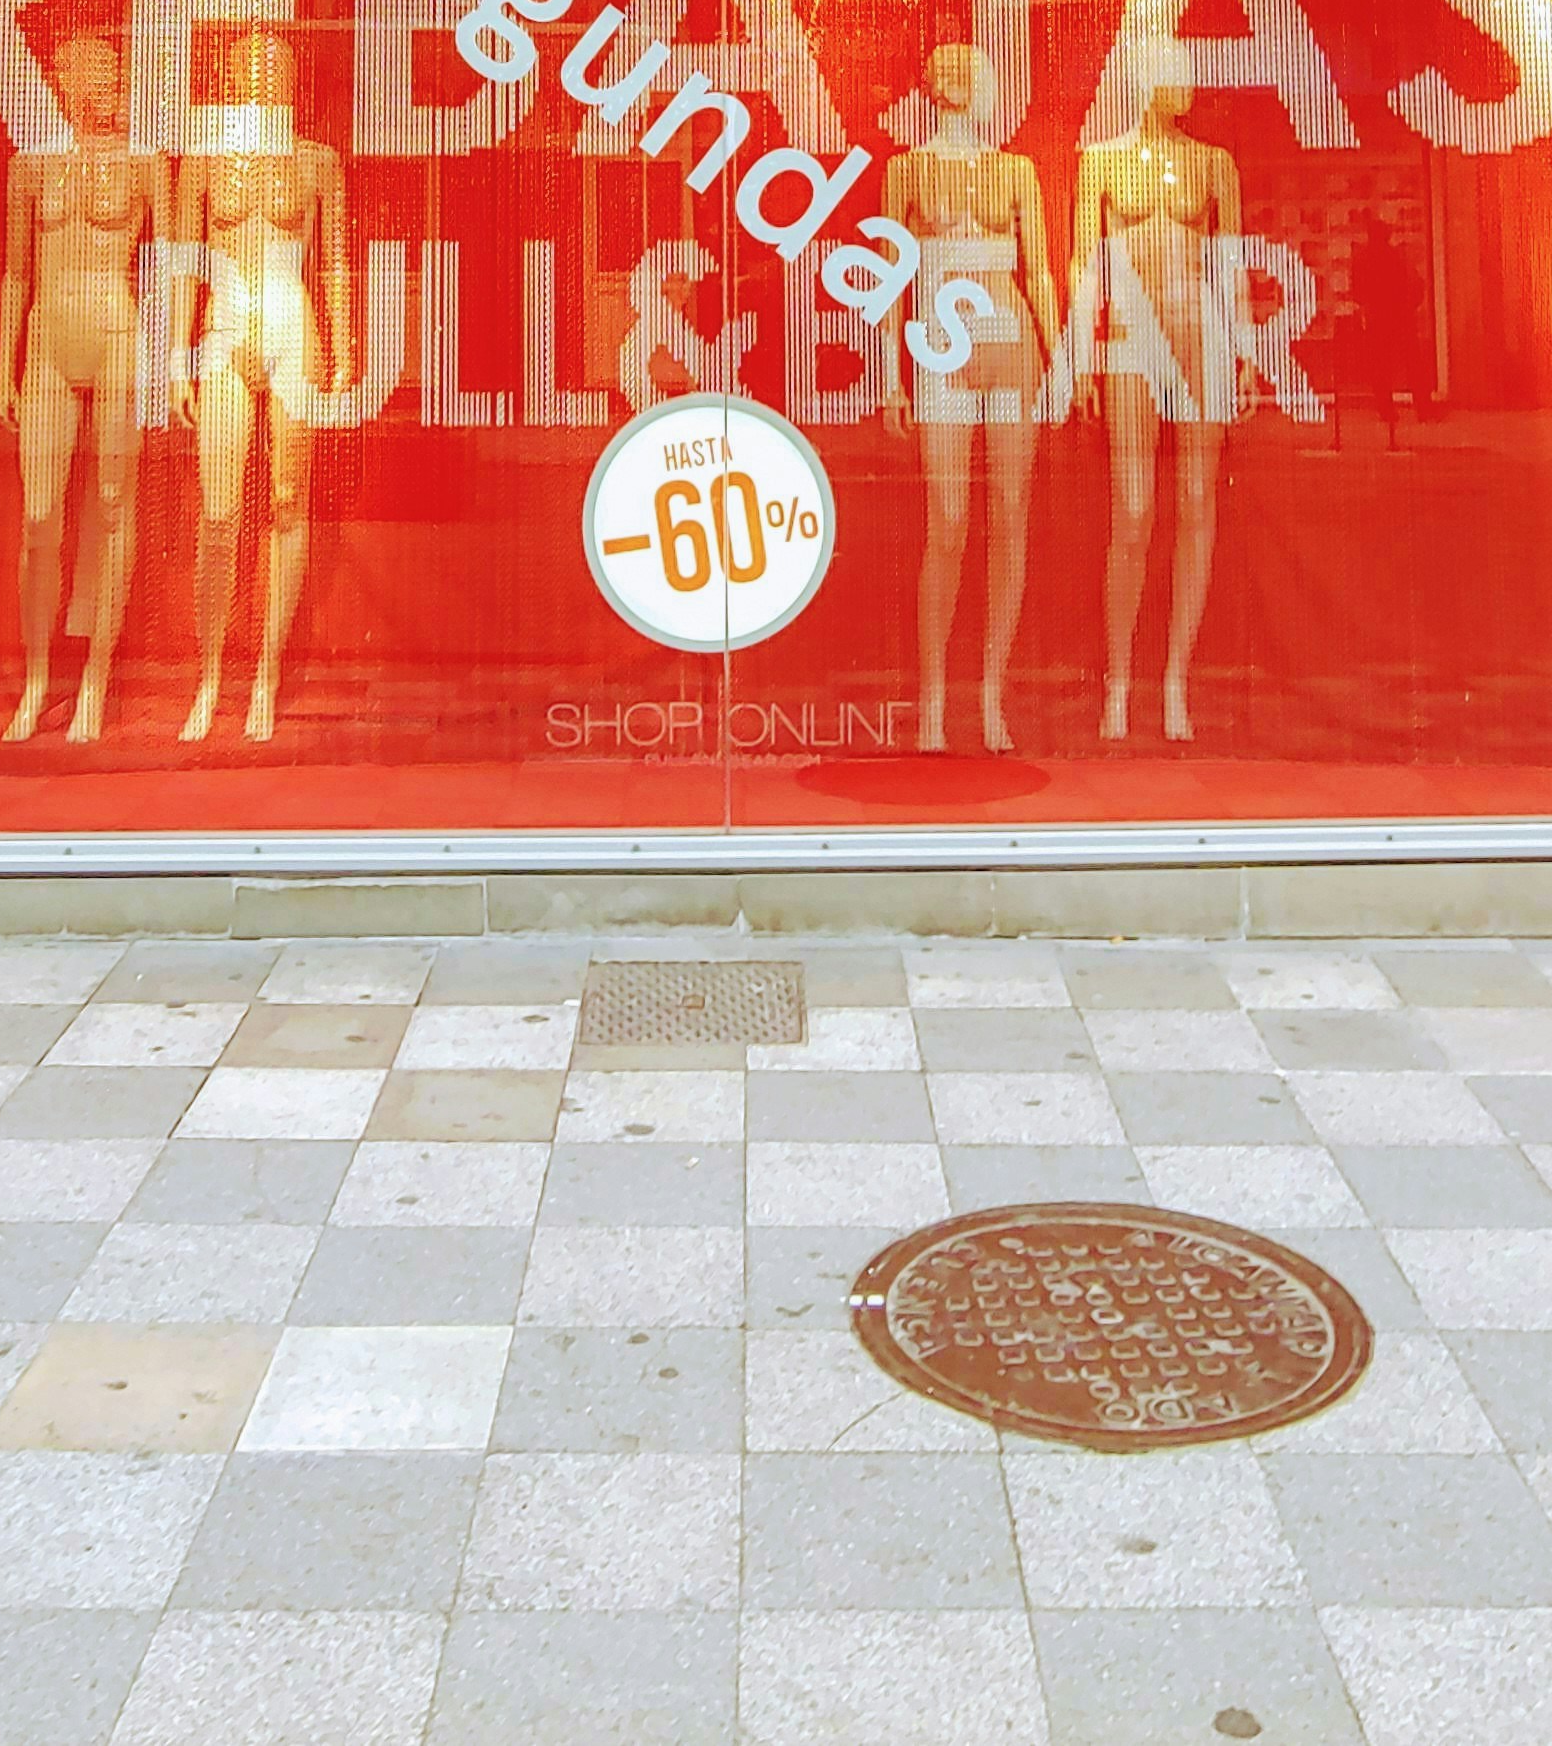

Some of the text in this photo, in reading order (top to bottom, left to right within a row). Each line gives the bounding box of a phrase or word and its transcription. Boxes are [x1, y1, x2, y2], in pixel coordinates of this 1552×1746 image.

[135, 234, 1328, 429] PULL&BEAR
[664, 436, 733, 472] HASTA
[603, 471, 819, 592] -60%
[545, 702, 703, 747] SHOP
